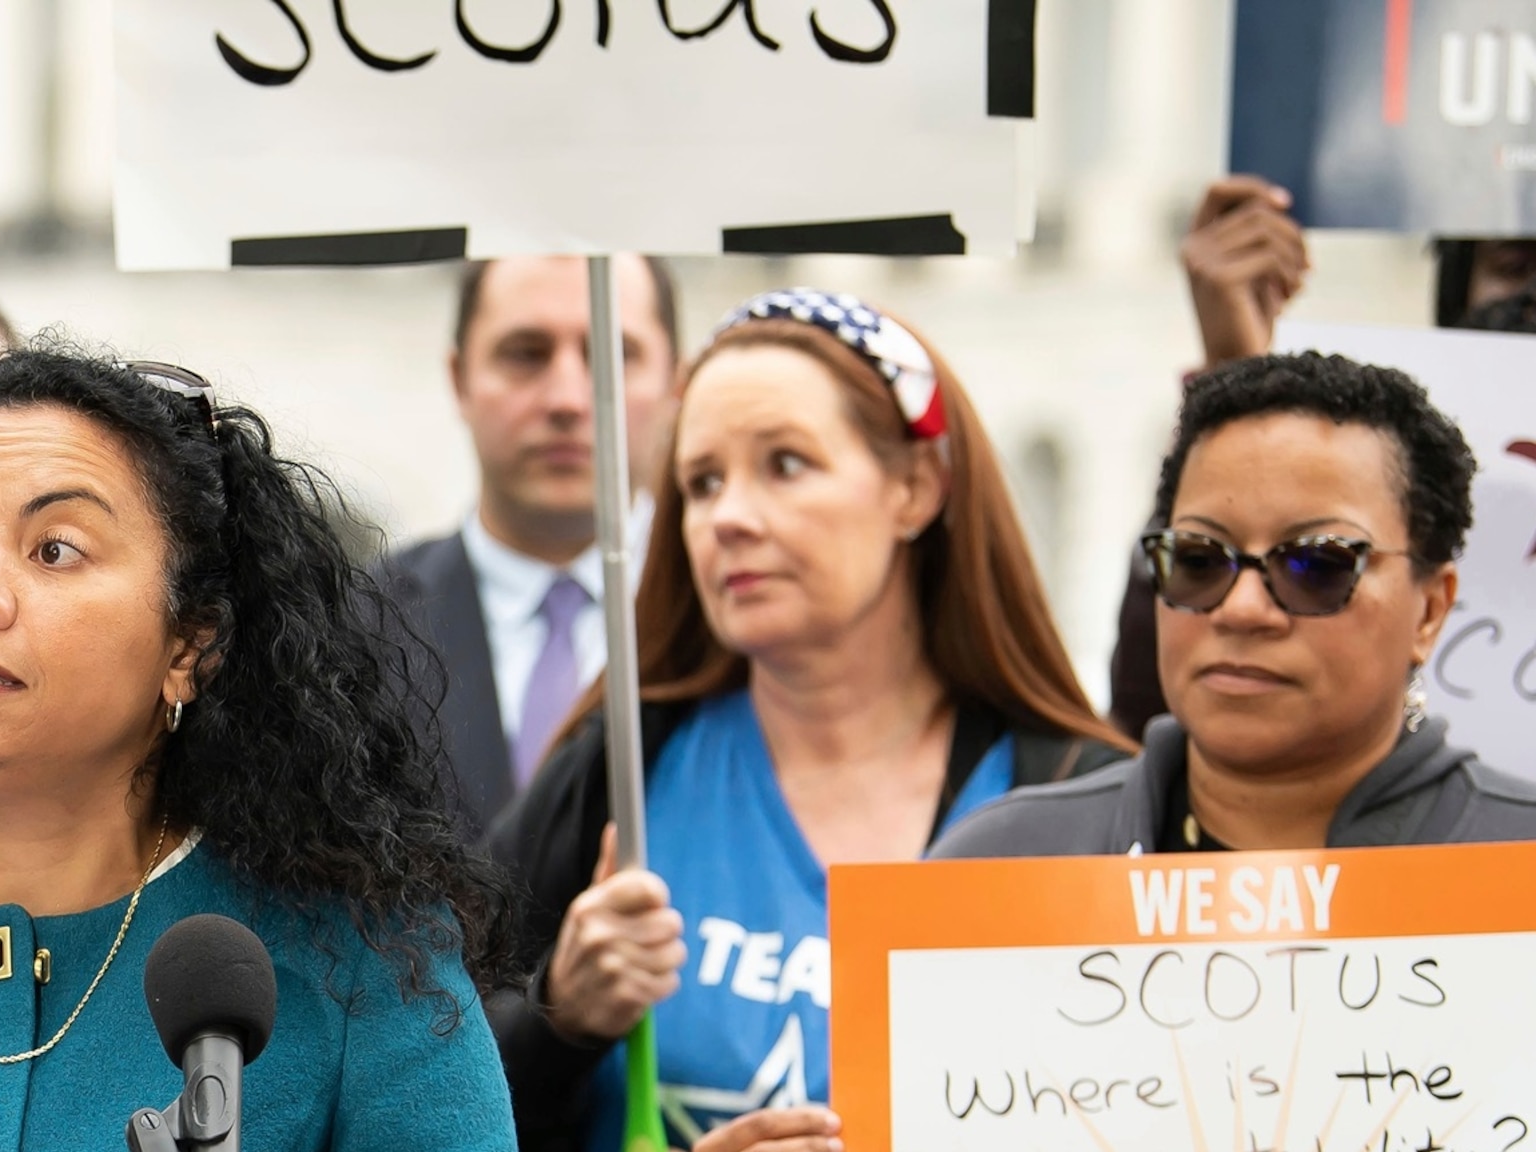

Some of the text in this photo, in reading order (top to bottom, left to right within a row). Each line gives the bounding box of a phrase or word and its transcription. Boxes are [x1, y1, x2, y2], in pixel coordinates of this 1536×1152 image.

[1128, 864, 1341, 937] WE SAY
[1057, 946, 1447, 1029] SCOTUS
[1224, 1060, 1281, 1102] is
[1335, 1050, 1464, 1105] the
